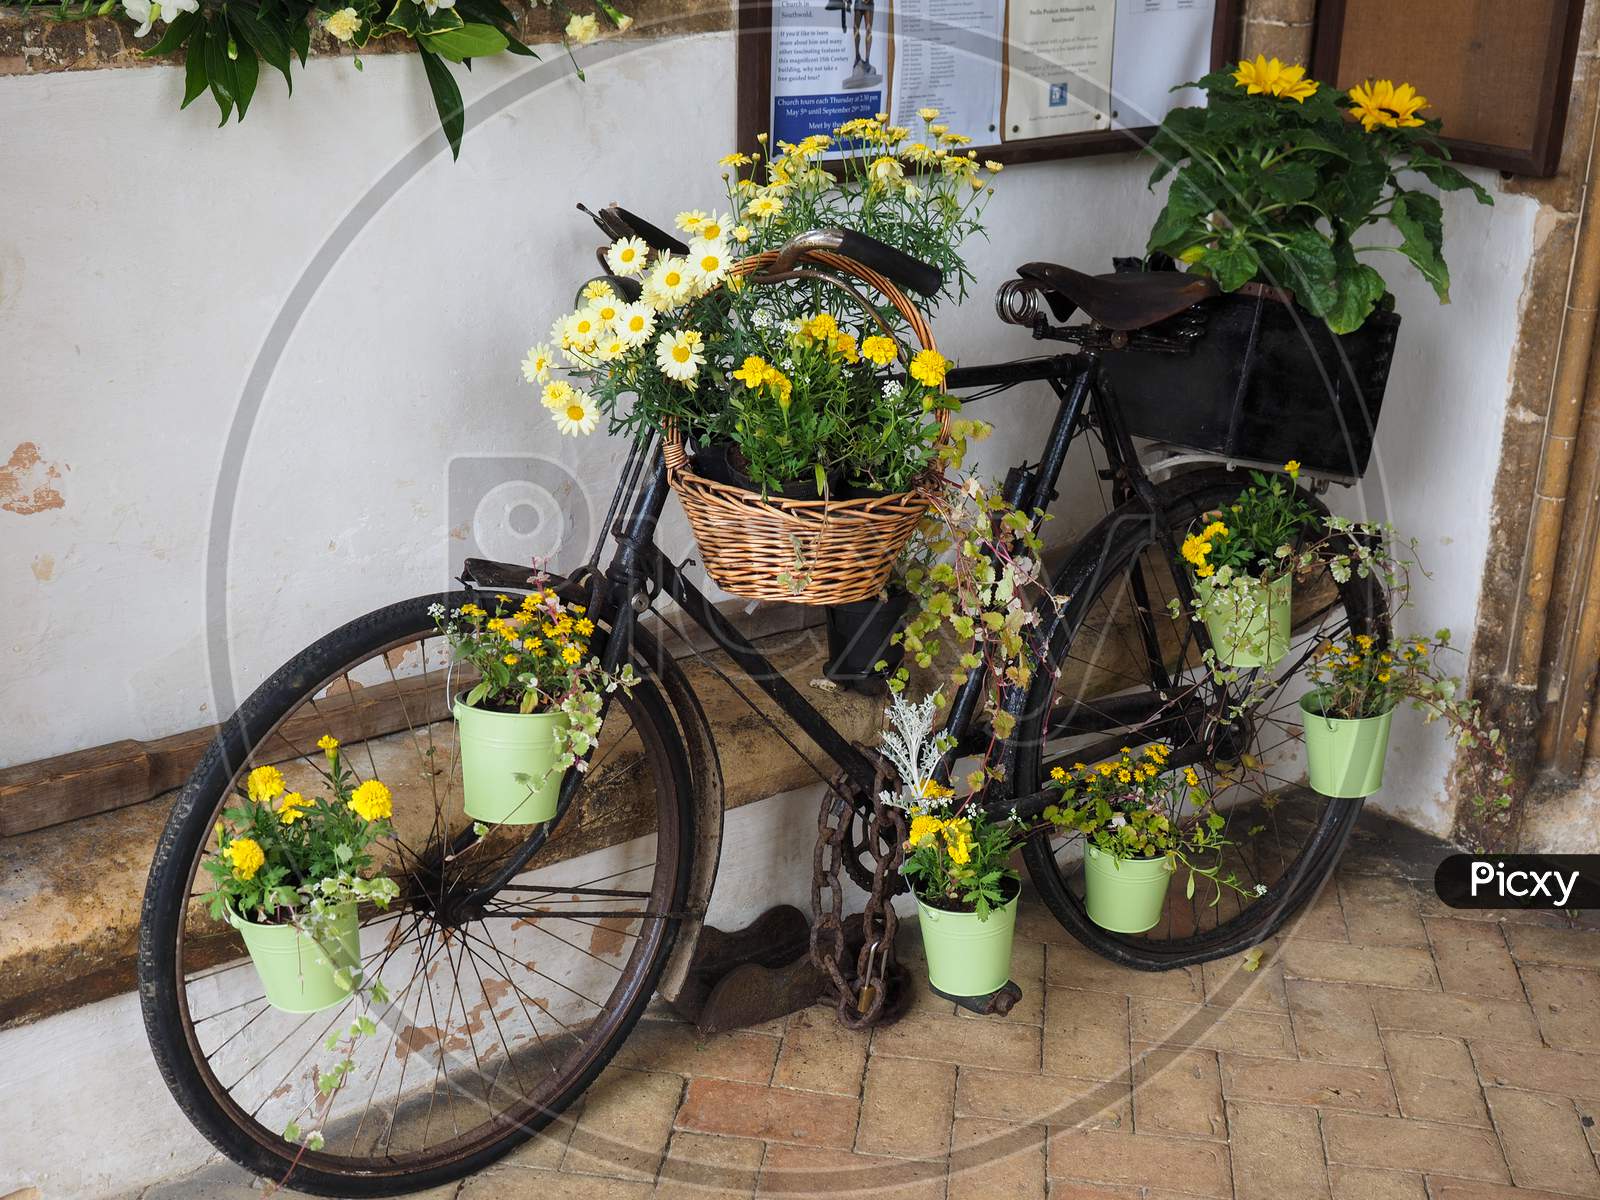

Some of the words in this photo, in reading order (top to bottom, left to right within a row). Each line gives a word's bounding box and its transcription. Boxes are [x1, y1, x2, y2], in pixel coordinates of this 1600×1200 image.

[778, 98, 800, 106] Church
[829, 96, 854, 105] Thursday
[786, 108, 799, 117] May
[808, 107, 822, 115] until
[822, 105, 851, 115] September
[823, 122, 832, 130] by
